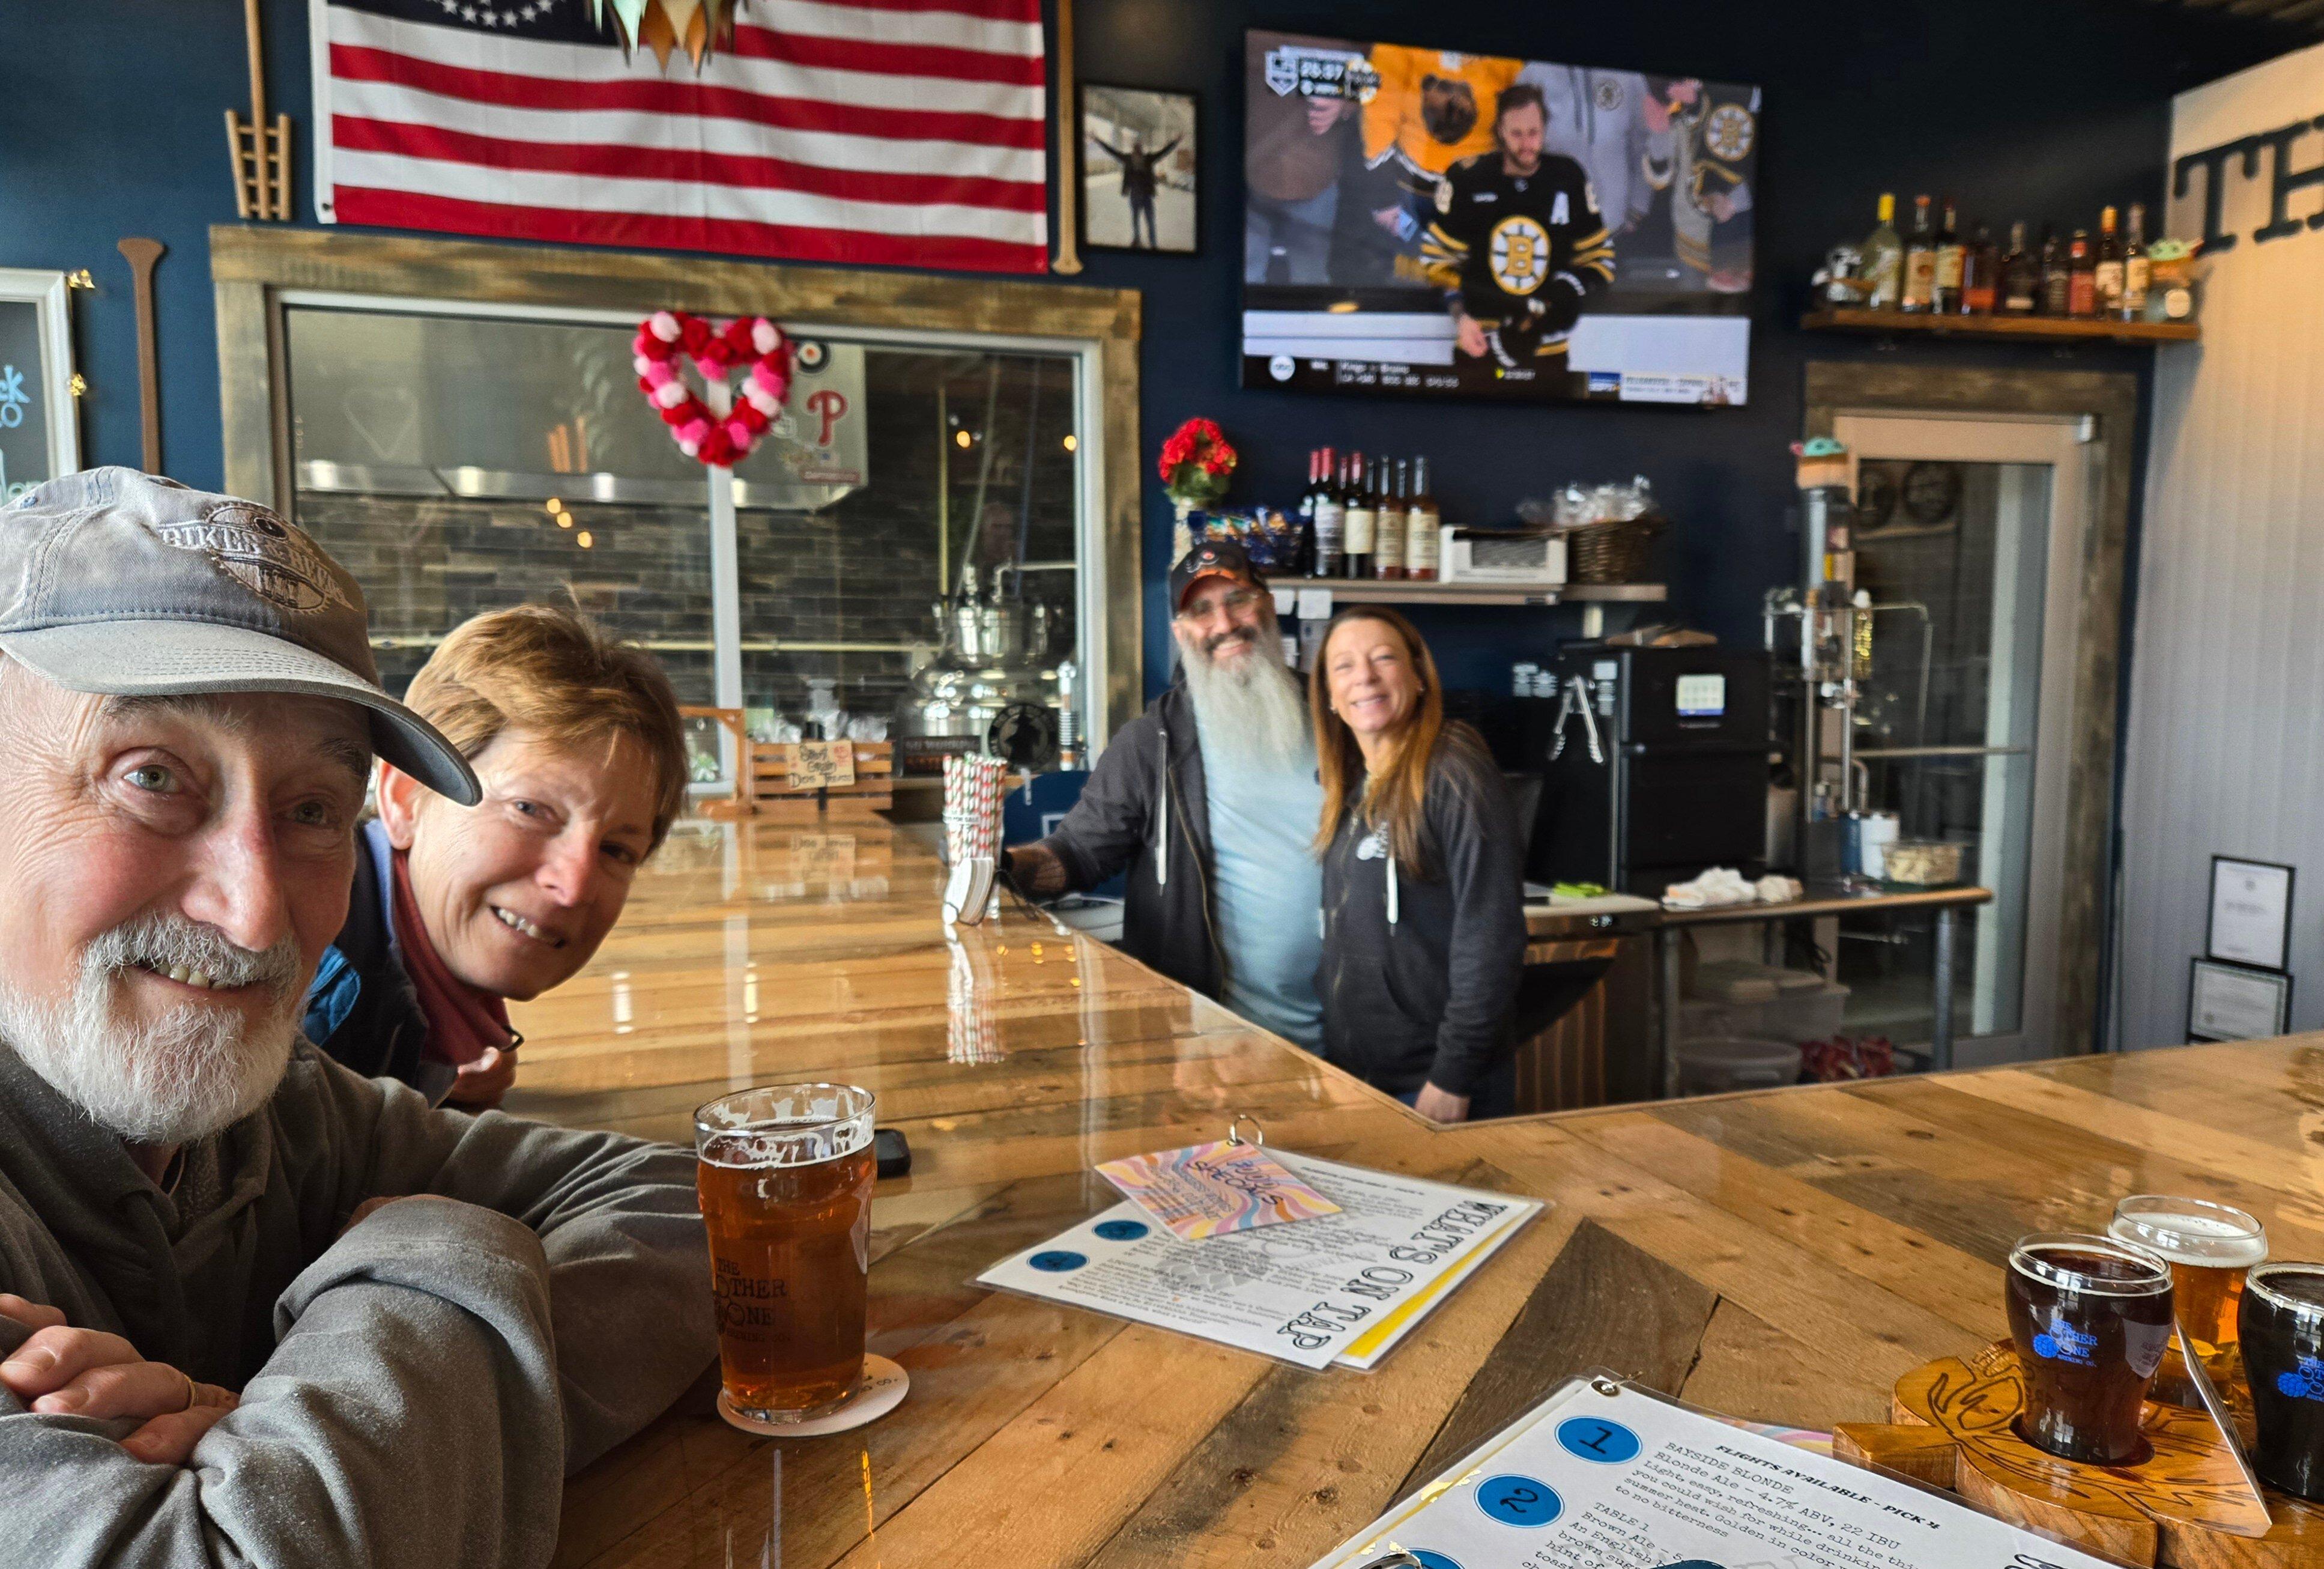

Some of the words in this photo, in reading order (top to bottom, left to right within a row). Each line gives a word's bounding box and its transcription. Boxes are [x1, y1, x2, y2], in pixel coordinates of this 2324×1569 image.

[806, 389, 848, 447] P
[716, 1257, 740, 1276] THE
[1340, 1266, 1414, 1300] ON
[716, 1275, 787, 1299] OTHER
[727, 1303, 775, 1326] ONE
[1277, 1302, 1371, 1350] TAP
[2049, 1326, 2098, 1346] OTHER
[2060, 1344, 2090, 1358] ONE
[1578, 1427, 1612, 1454] 1
[1665, 1442, 1729, 1470] BAYSIDE
[1732, 1467, 1794, 1495] BLONDE
[1715, 1445, 1782, 1471] FLIGHTS
[1781, 1469, 1872, 1504] AVAILABLE
[1882, 1505, 1926, 1525] PICK
[1499, 1488, 1539, 1513] 2
[1593, 1502, 1638, 1526] TABLE
[1615, 1485, 1629, 1496] to
[1633, 1493, 1650, 1504] no
[1653, 1501, 1729, 1538] bitterness
[1631, 1470, 1659, 1484] you
[1662, 1481, 1700, 1501] could
[1705, 1497, 1737, 1516] wish
[1741, 1513, 1766, 1528] for
[1769, 1525, 1812, 1544] while
[1643, 1460, 1684, 1482] Light,
[1689, 1479, 1723, 1498] easy,
[1727, 1495, 1823, 1536] refreshing...
[1827, 1534, 1852, 1548] all
[1858, 1545, 1883, 1559] the
[1653, 1451, 1709, 1477] Blonde
[1712, 1475, 1739, 1490] Ale
[1758, 1492, 1799, 1510] 4.7%
[1800, 1507, 1835, 1528] ABV,
[1841, 1523, 1863, 1536] 22
[1865, 1532, 1902, 1550] IBU
[1581, 1511, 1626, 1536] Brown
[1629, 1534, 1656, 1549] Ale
[1624, 1477, 1673, 1501] summer
[1675, 1499, 1710, 1517] heat.
[1715, 1515, 1765, 1540] Golden
[1768, 1534, 1787, 1548] in
[1791, 1547, 1835, 1568] color
[1545, 1540, 1582, 1561] hint
[1584, 1559, 1605, 1569] of
[1558, 1530, 1603, 1556] brown
[1569, 1522, 1588, 1534] An
[1591, 1531, 1652, 1564] English
